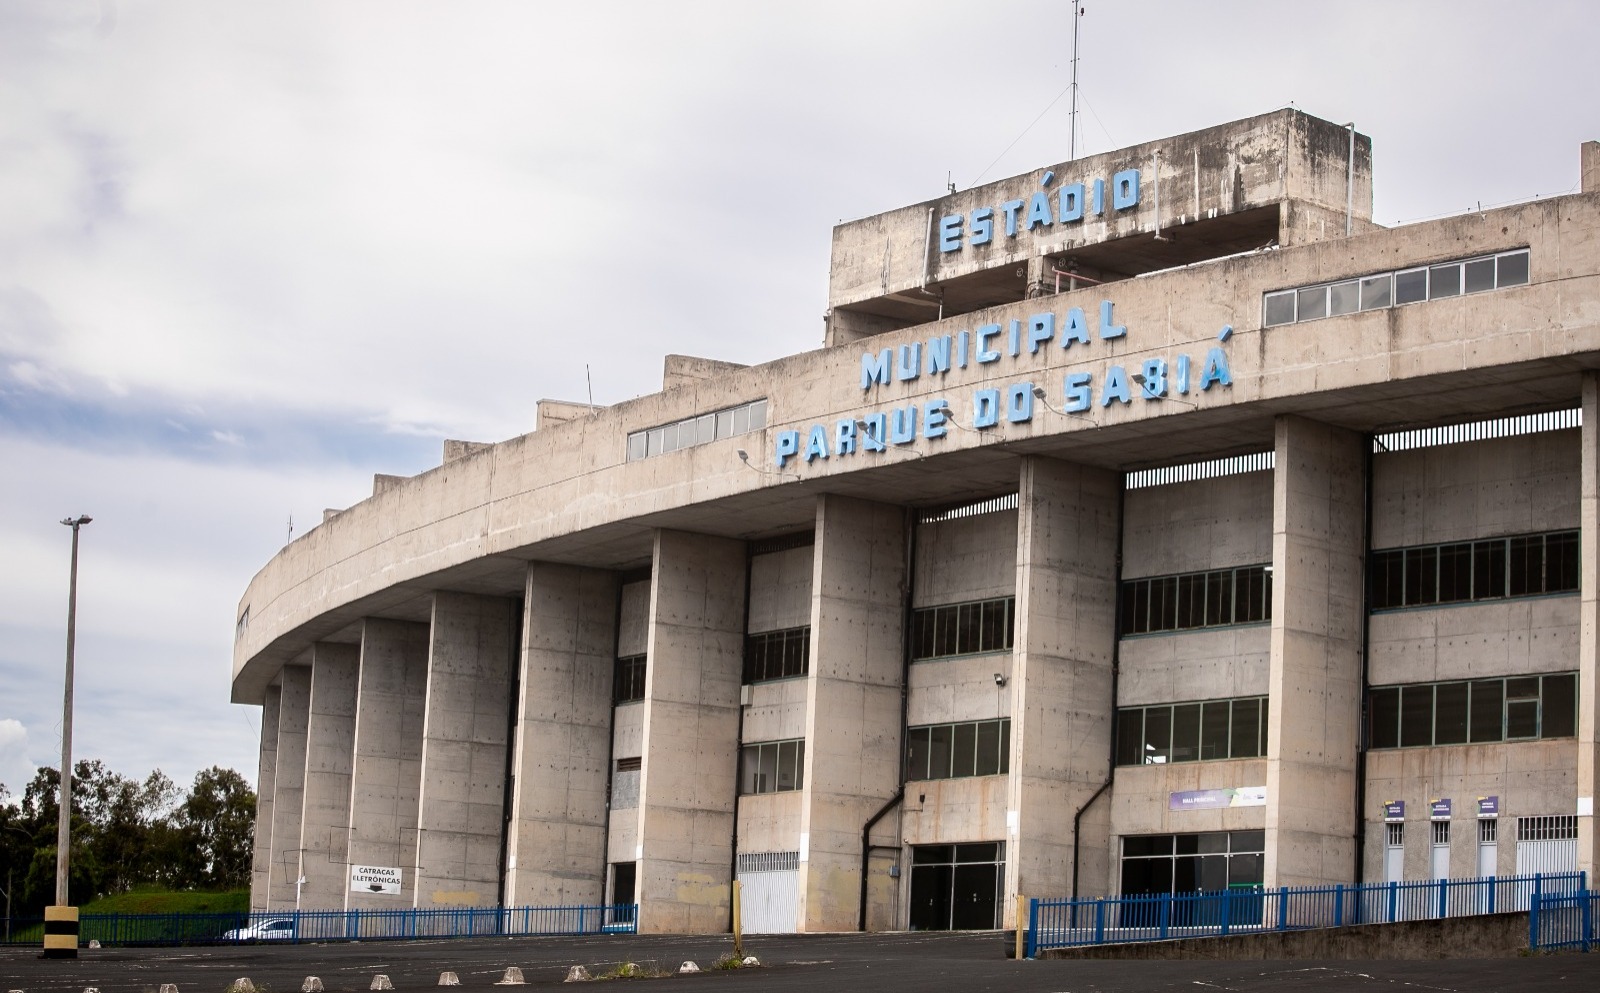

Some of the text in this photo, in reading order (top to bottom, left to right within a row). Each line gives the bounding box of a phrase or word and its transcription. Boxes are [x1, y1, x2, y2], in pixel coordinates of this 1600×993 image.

[939, 169, 1141, 253] ESTÁDIO
[861, 300, 1127, 390] MUNICIPAL
[775, 325, 1234, 467] PARQUE DO SABIÁ
[353, 875, 400, 884] ELETRÔNICAS
[359, 867, 395, 875] CATRACAS
